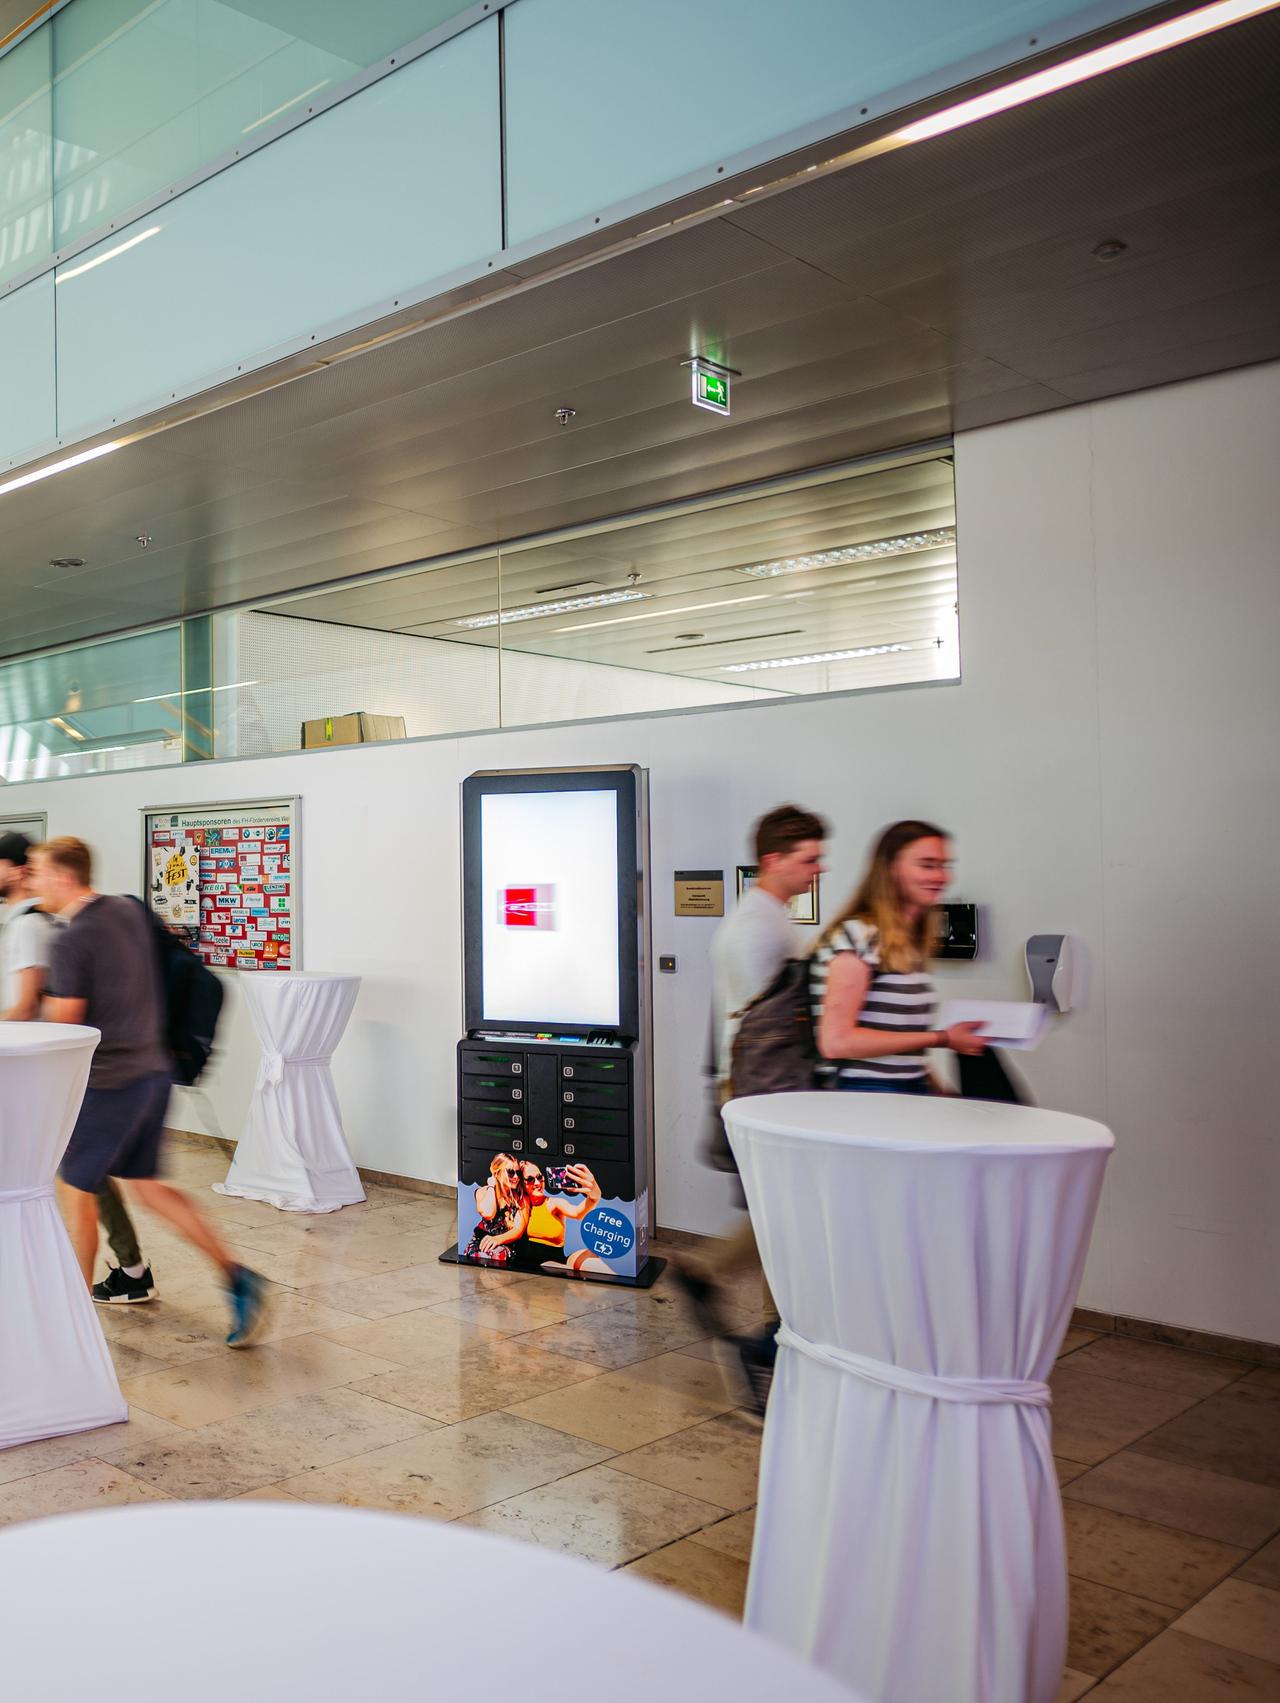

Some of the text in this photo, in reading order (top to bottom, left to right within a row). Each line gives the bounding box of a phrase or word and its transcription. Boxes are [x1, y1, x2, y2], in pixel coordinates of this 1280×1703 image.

[181, 818, 232, 828] Hauptsponsoren
[165, 868, 187, 884] FEST
[598, 1211, 623, 1228] Free
[583, 1221, 631, 1248] Charging
